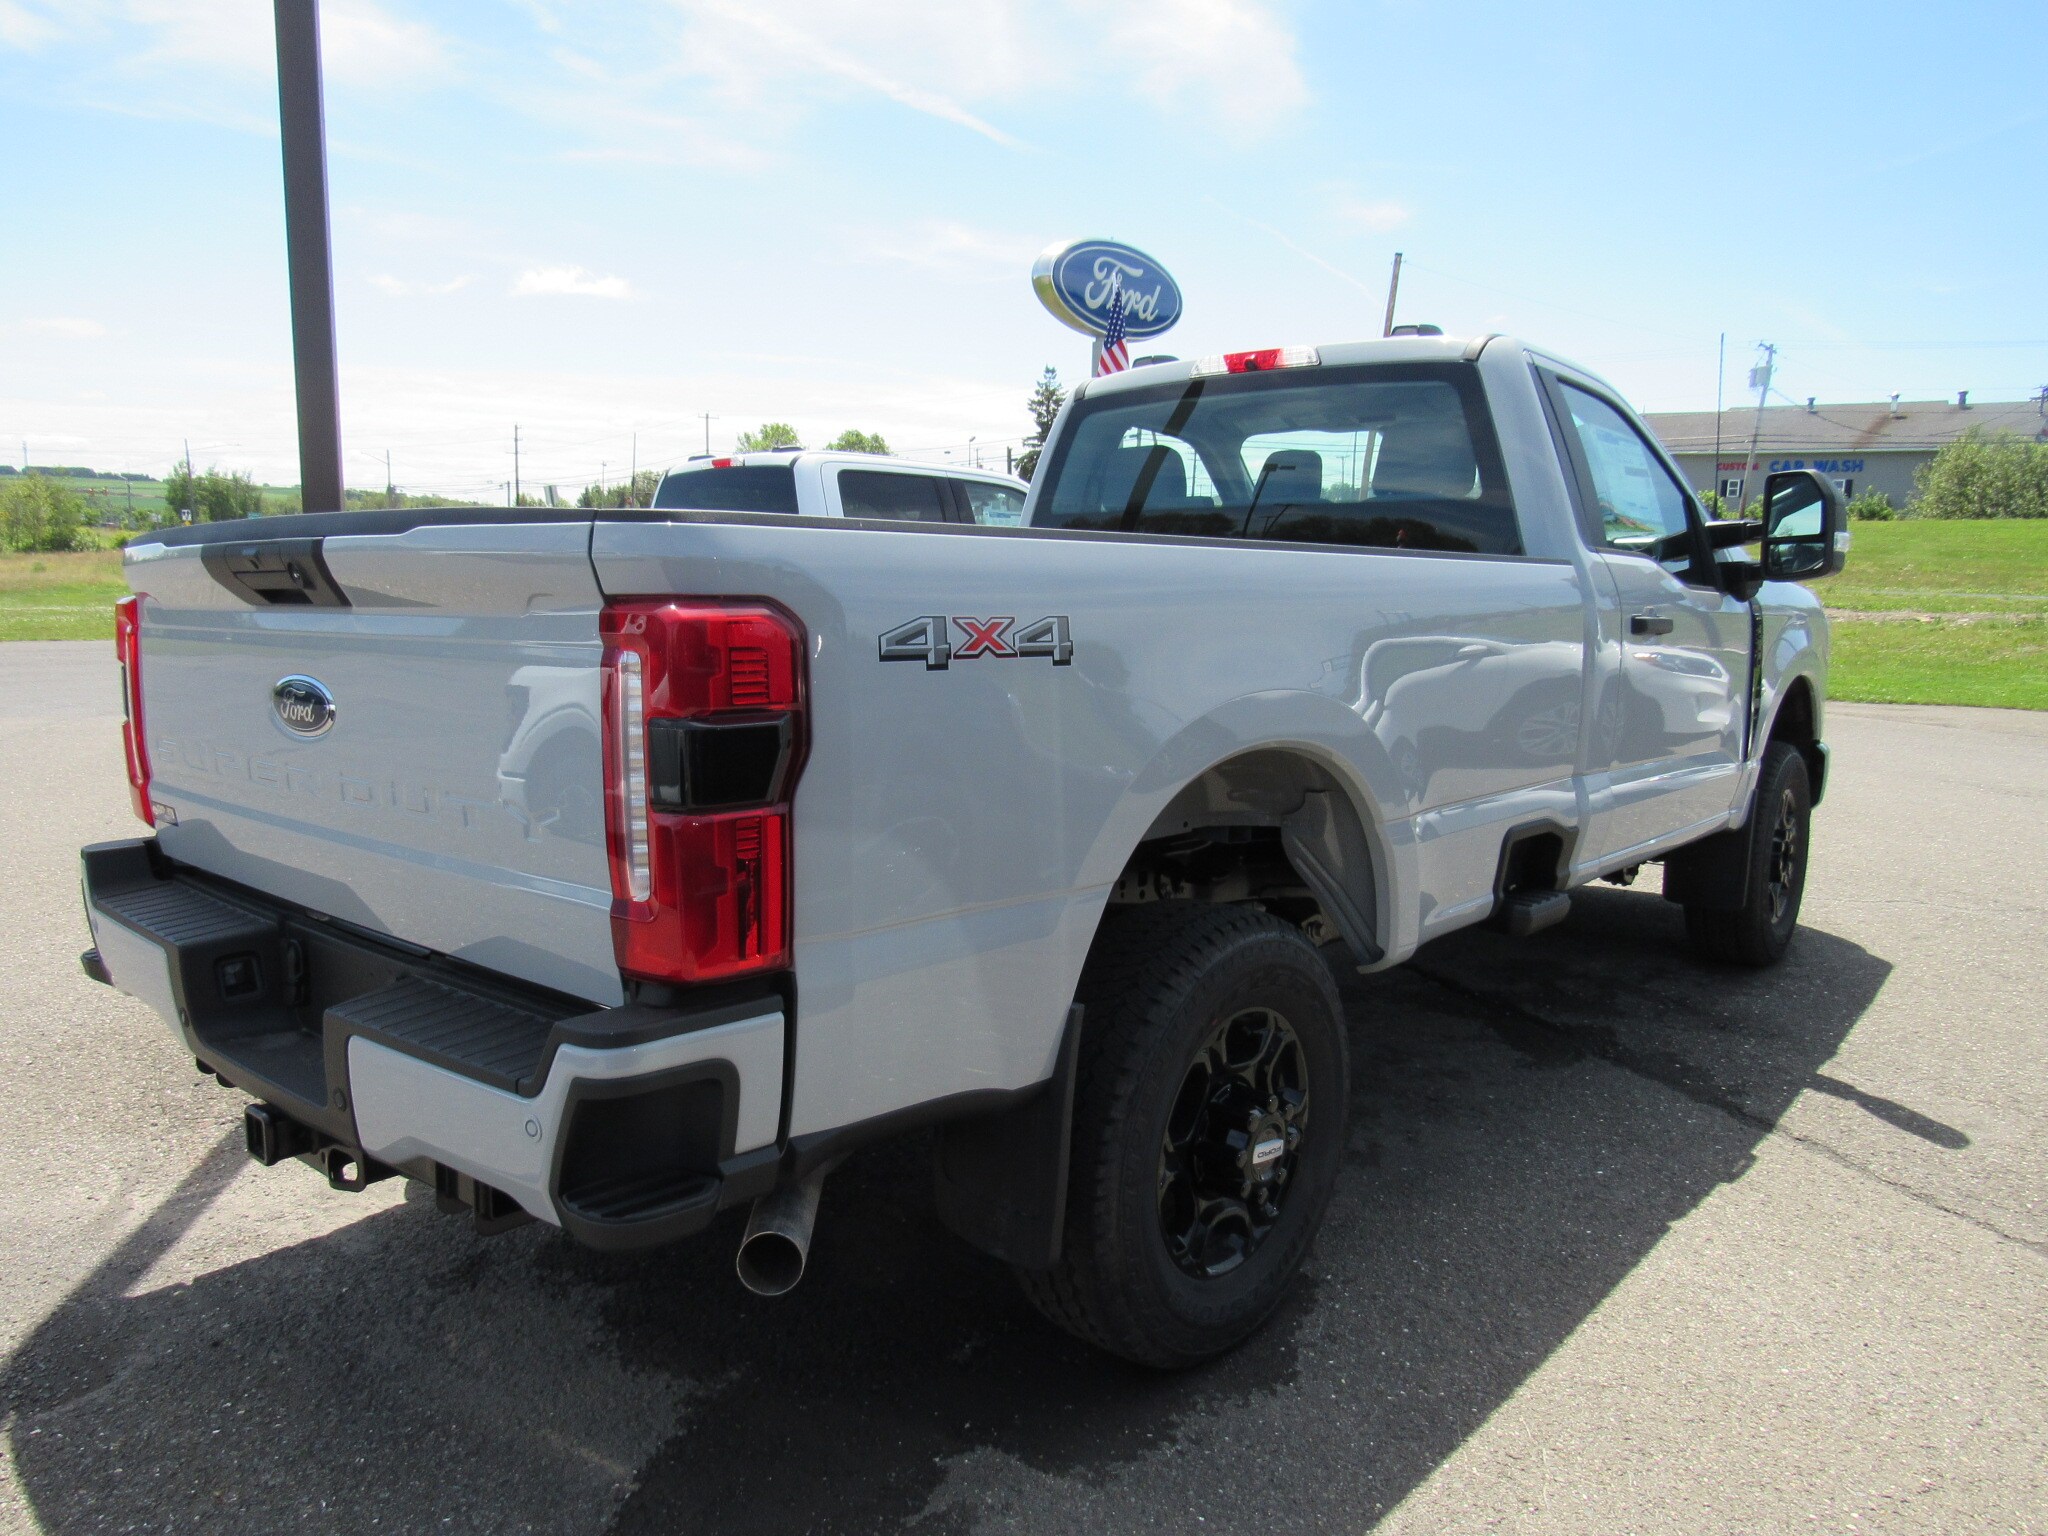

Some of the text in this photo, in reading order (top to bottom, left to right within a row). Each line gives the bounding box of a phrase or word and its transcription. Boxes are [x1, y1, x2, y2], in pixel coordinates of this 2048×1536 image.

[1769, 459, 1864, 473] CAR WASH
[878, 615, 1074, 671] 4X4
[280, 687, 315, 722] Ford
[157, 737, 560, 843] SUPER DUTY
[1257, 1145, 1282, 1159] FORD
